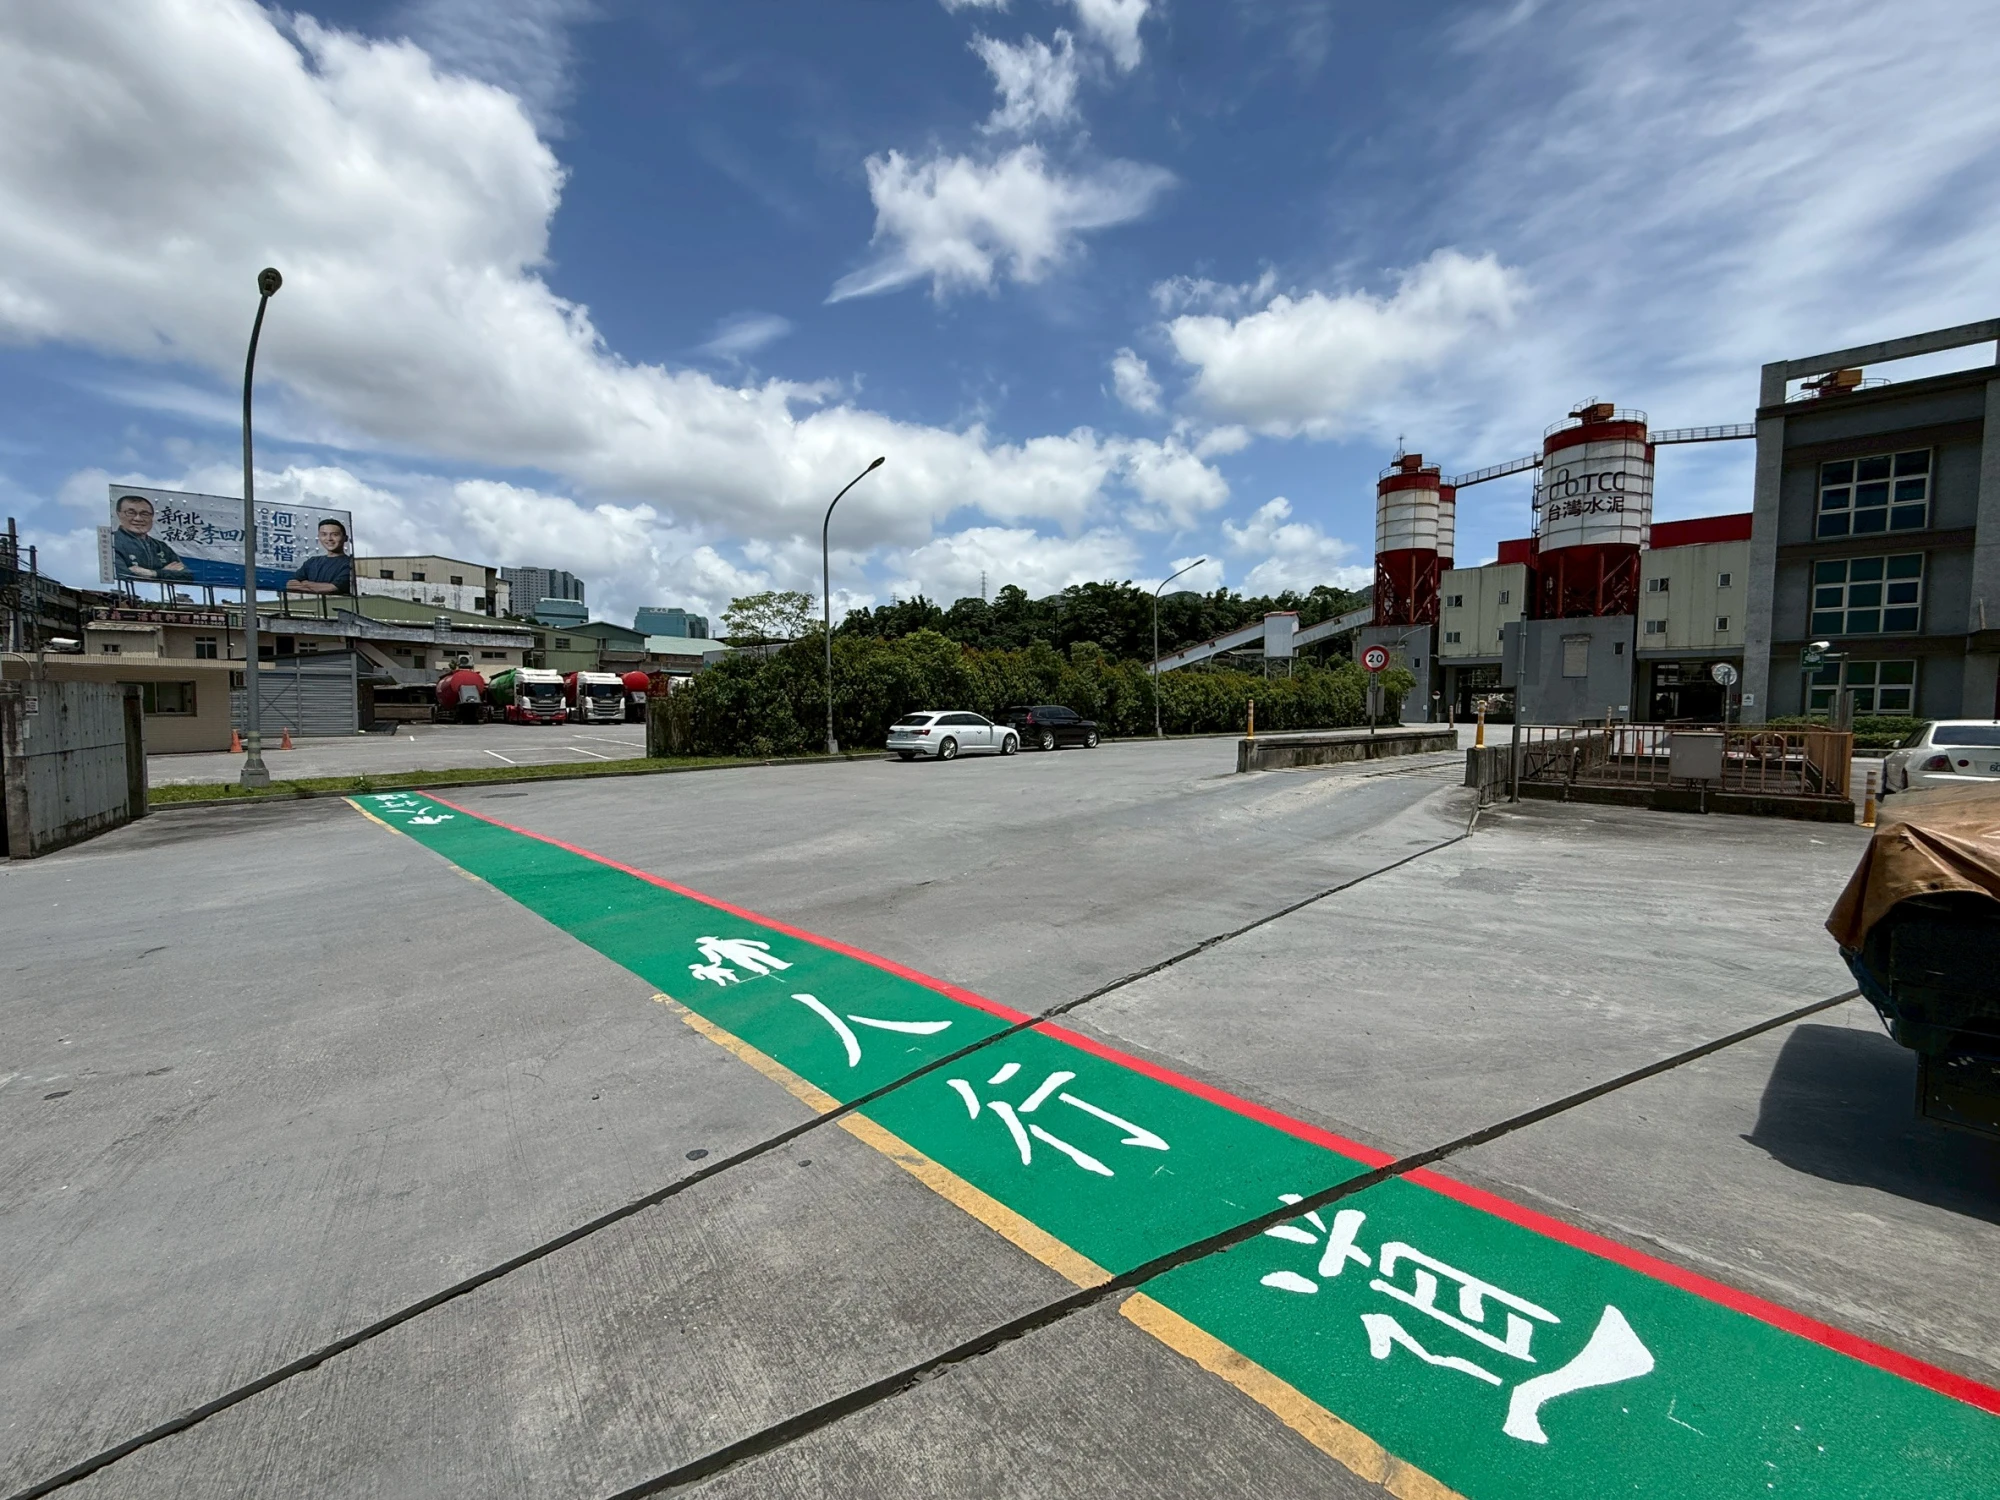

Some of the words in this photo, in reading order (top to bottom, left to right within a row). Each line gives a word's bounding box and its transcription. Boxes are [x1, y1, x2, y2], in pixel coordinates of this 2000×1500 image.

[1580, 471, 1626, 492] TCC
[158, 506, 204, 527] 新北
[1549, 496, 1624, 522] 台灣水泥
[272, 511, 294, 562] 何元楷
[1368, 654, 1383, 663] 20
